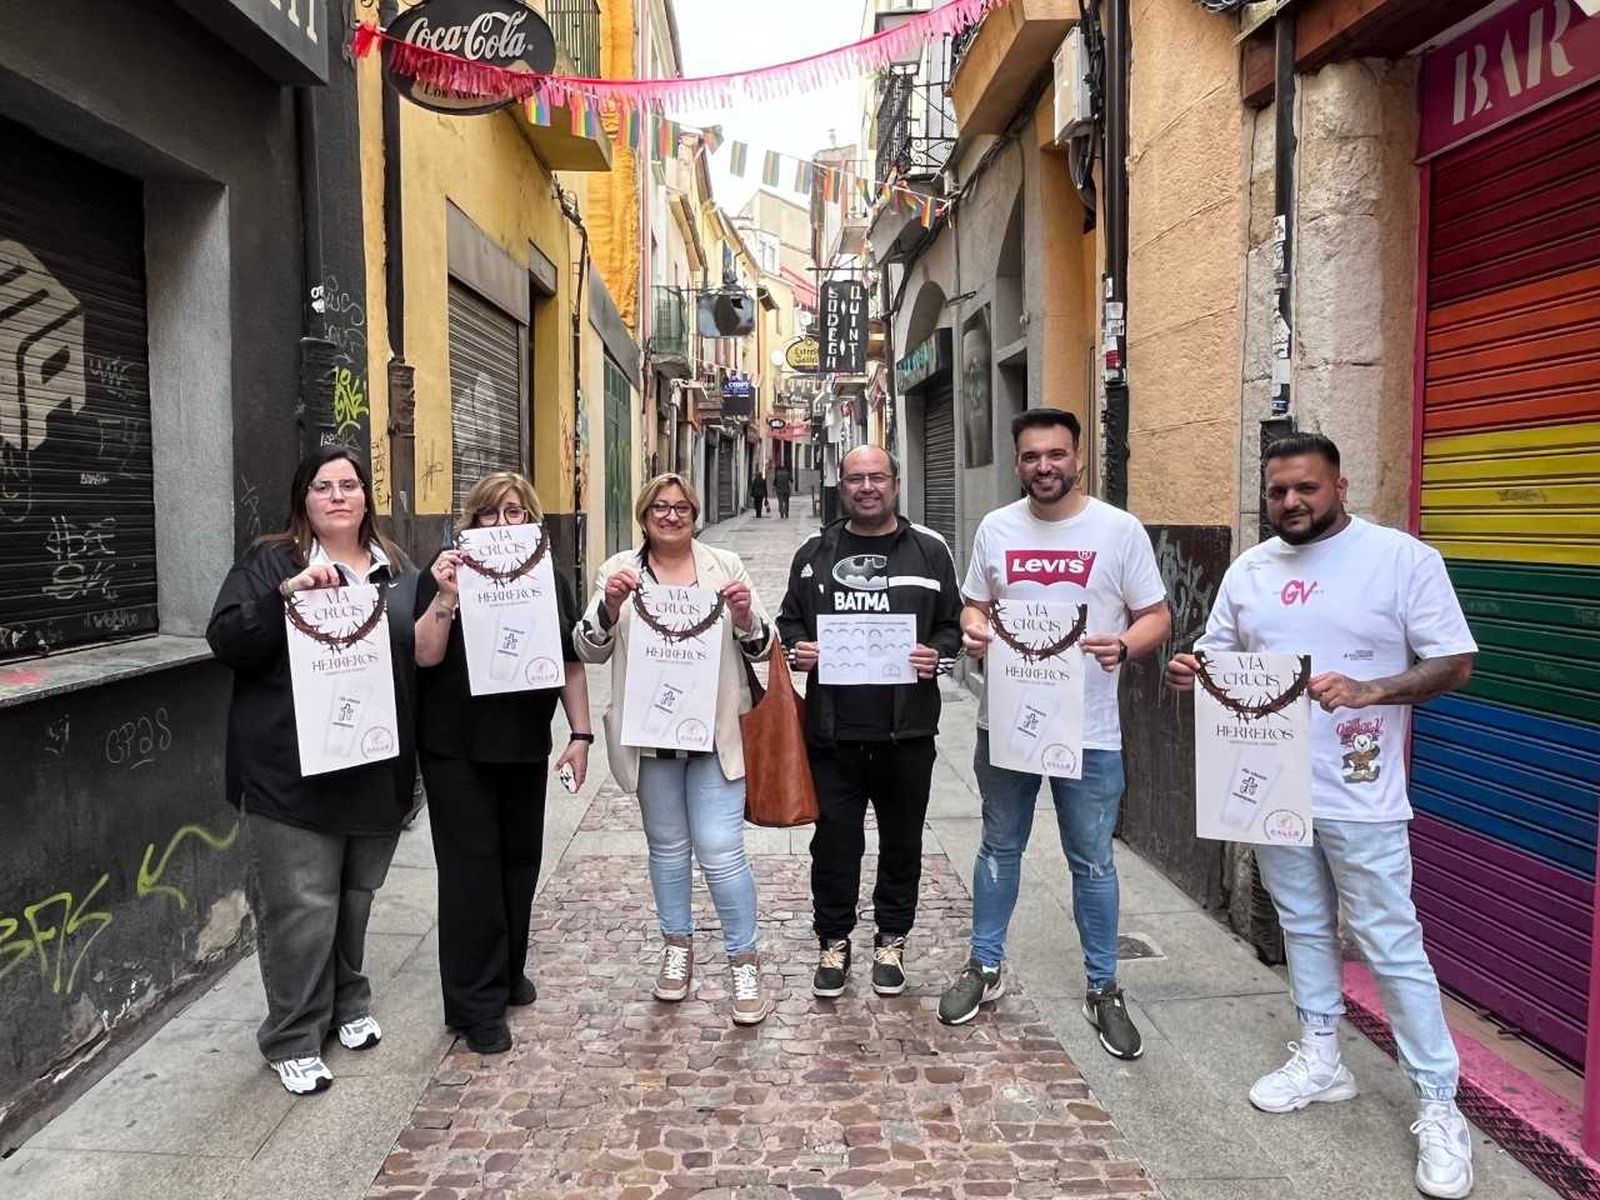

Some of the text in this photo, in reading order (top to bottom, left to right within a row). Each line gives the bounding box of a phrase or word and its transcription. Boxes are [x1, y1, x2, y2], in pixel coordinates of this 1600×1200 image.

[1453, 0, 1574, 125] BAR
[833, 591, 890, 612] BATMA
[1280, 579, 1317, 606] GV
[1005, 665, 1071, 682] HERREROS
[1223, 671, 1280, 687] CRUCIS
[1216, 724, 1295, 741] HERREROS
